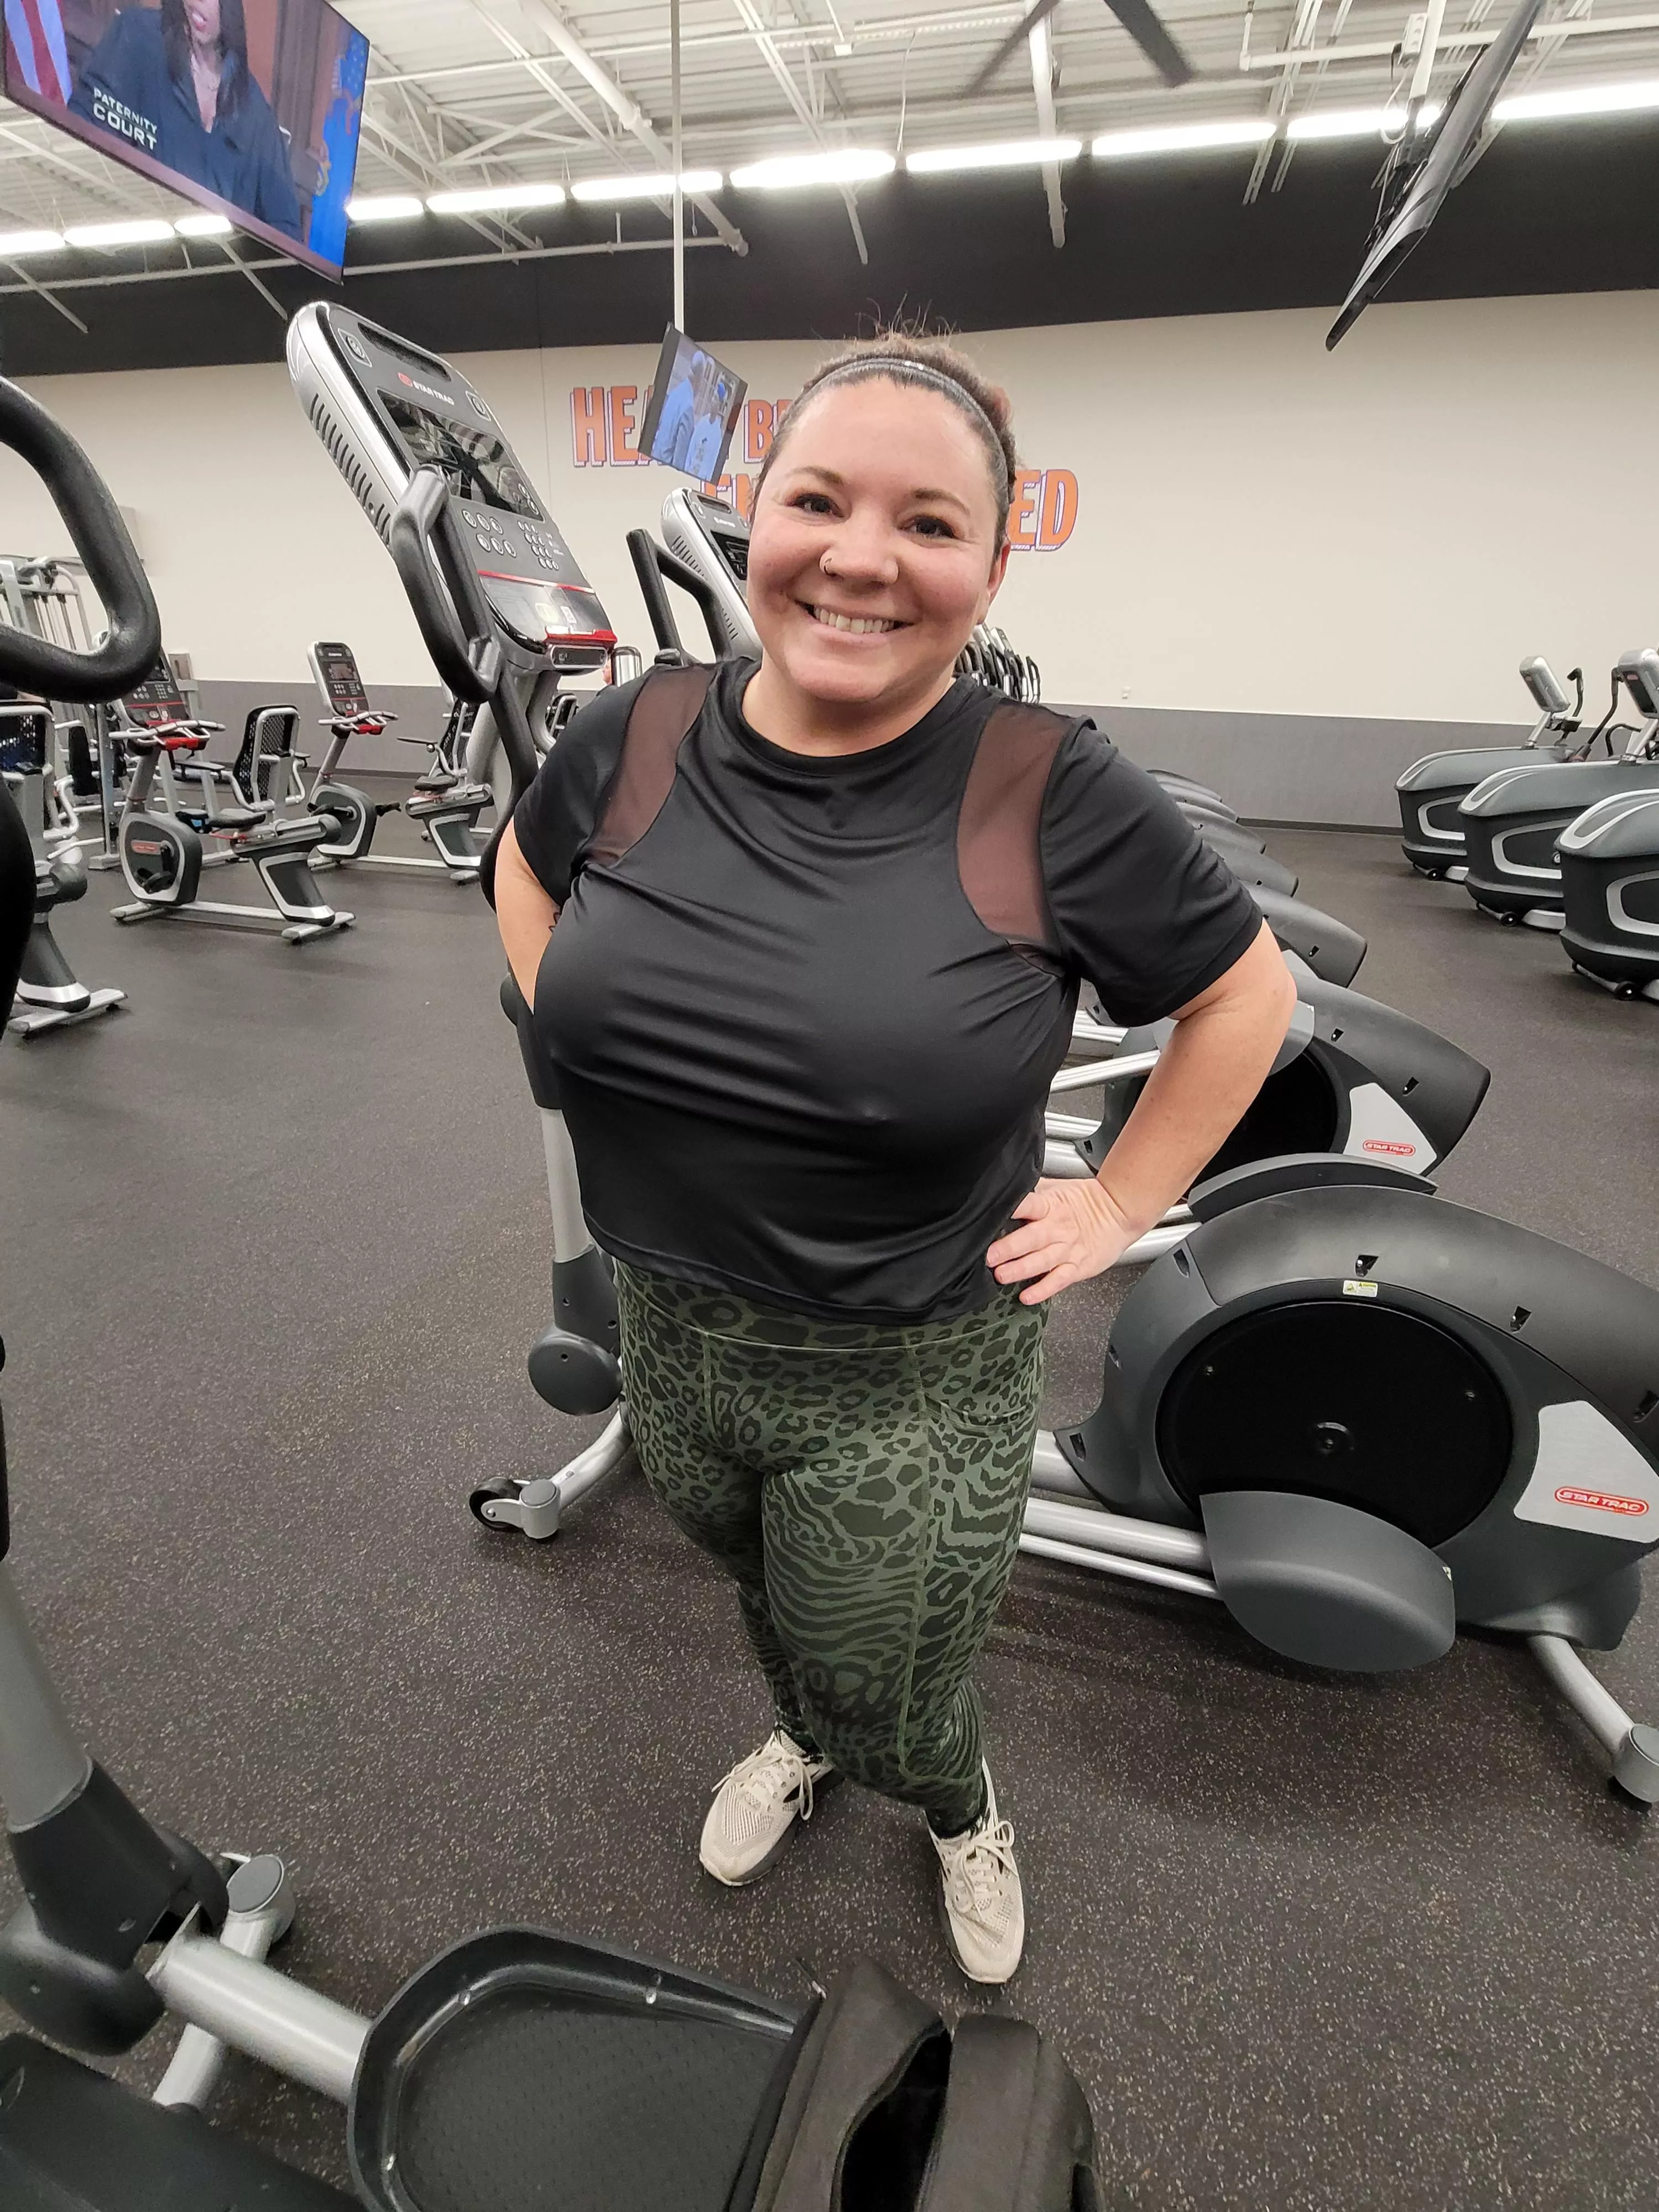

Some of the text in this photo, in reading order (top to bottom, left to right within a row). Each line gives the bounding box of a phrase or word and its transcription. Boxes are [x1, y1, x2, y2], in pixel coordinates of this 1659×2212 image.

[93, 86, 157, 134] PATERNITY
[93, 102, 157, 150] COURT
[1561, 1491, 1641, 1511] STAR TRAC
